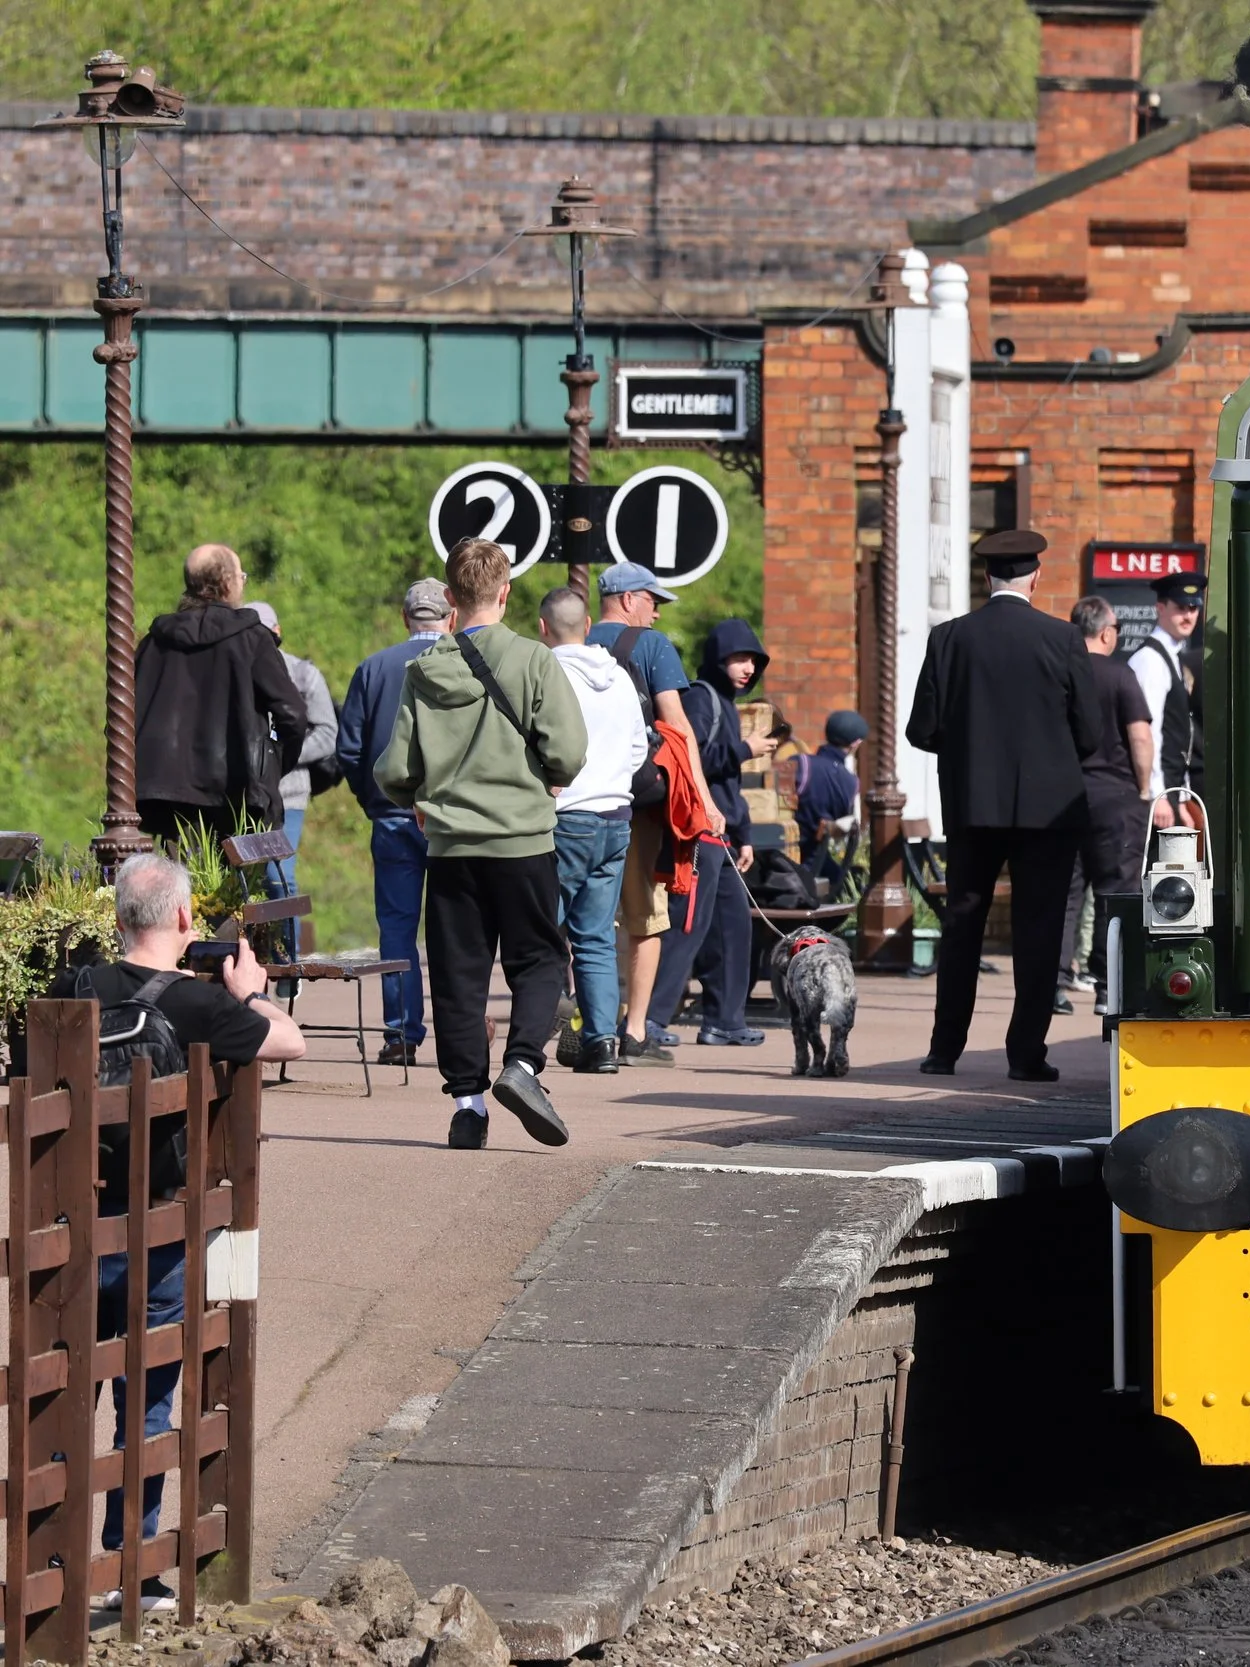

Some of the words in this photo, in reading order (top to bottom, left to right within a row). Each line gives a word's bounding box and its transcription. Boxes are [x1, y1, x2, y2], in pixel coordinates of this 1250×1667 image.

[631, 393, 733, 415] GENTLEMEN
[465, 479, 516, 564] 2
[655, 484, 680, 569] 1
[1111, 552, 1183, 574] LNER
